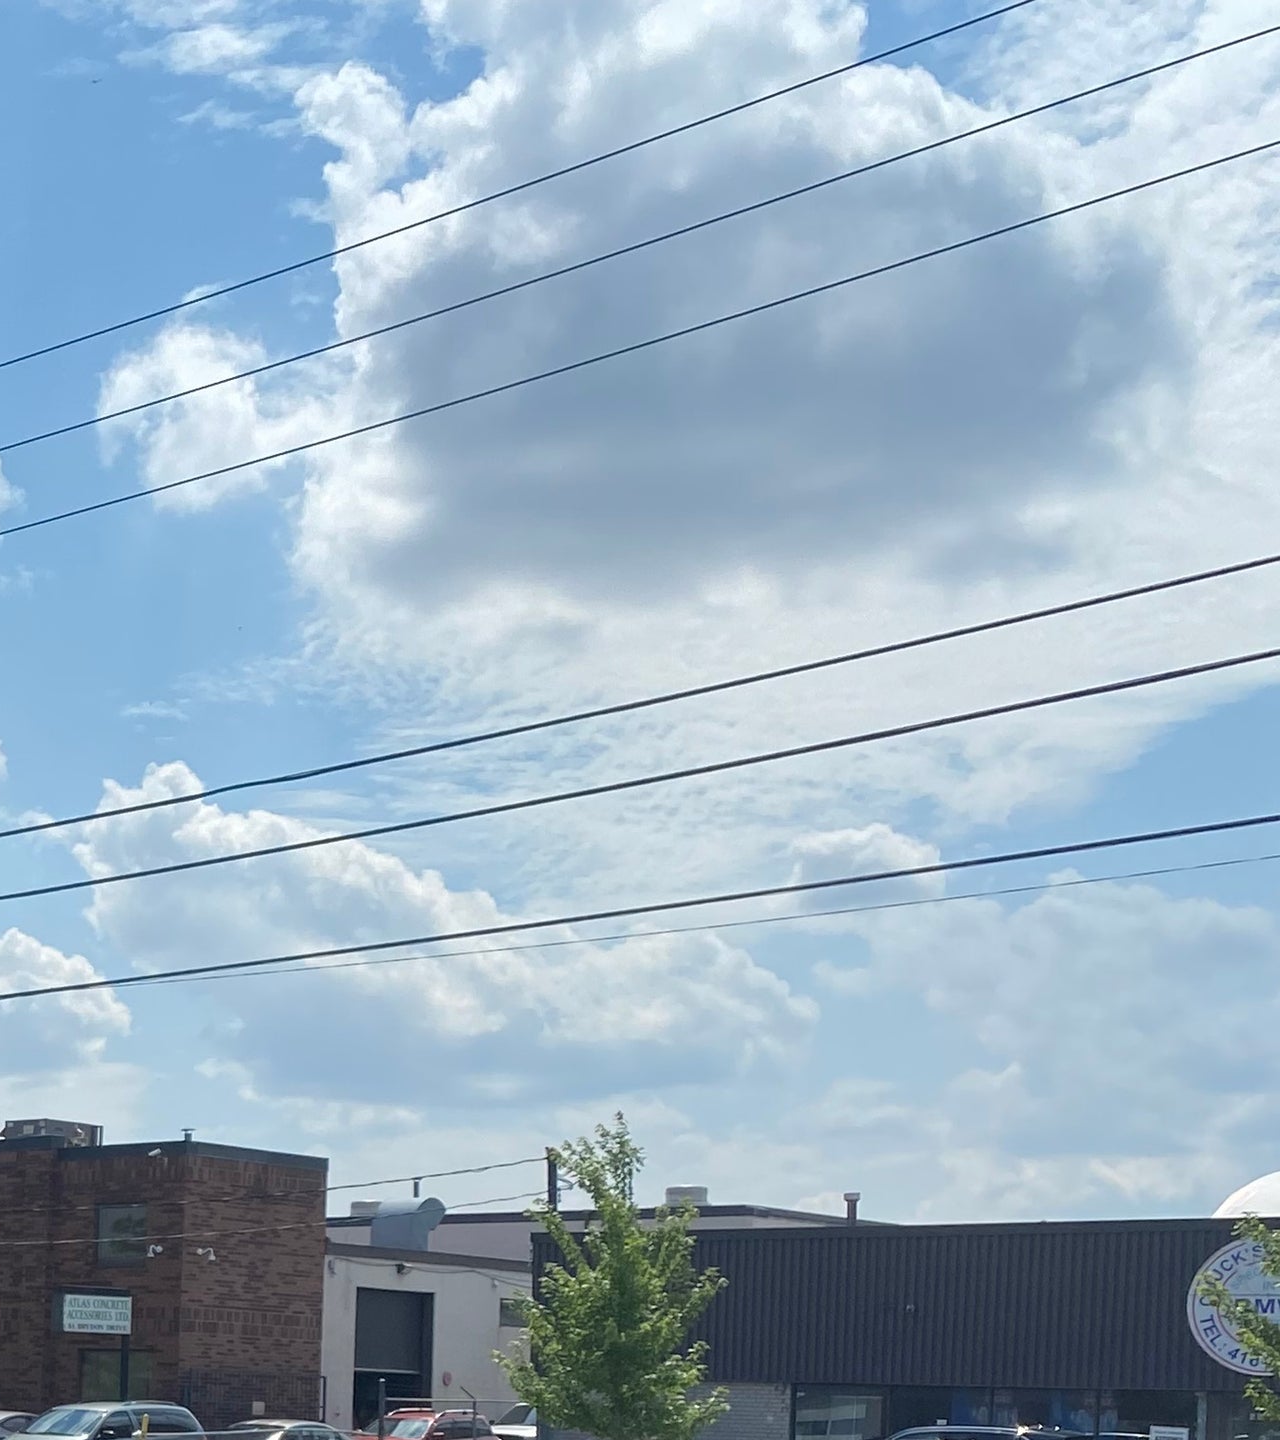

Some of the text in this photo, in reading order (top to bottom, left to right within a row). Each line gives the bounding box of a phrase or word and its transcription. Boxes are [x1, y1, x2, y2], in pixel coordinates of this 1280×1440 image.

[1199, 1244, 1263, 1307] CUCK'S
[66, 1309, 113, 1321] ACCESSORIES
[68, 1297, 130, 1311] ATLAS CONCRETE
[1199, 1314, 1228, 1352] TEL:
